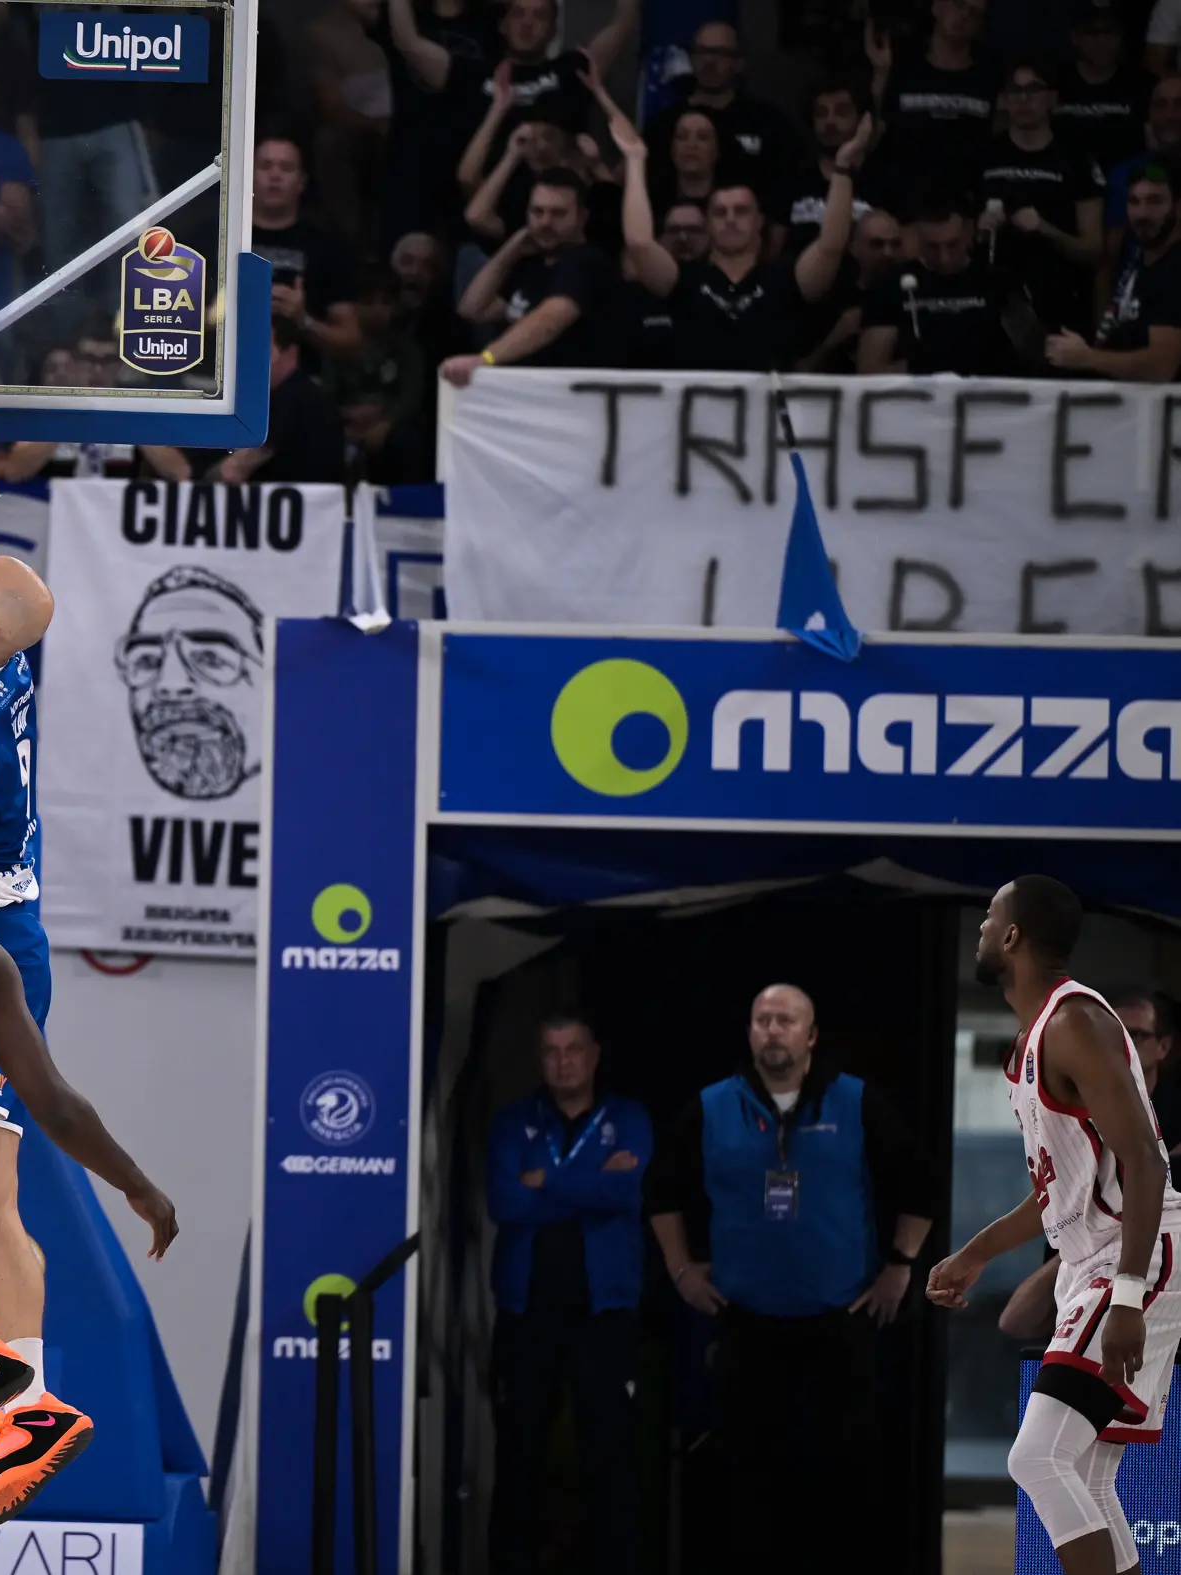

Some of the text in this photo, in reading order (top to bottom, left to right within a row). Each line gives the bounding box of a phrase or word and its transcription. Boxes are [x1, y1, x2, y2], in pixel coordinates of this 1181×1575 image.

[76, 22, 181, 71] Unipol
[134, 287, 195, 311] LBA
[144, 315, 183, 323] SERIE A
[138, 337, 188, 360] Unipol
[122, 482, 305, 553] CIANO
[711, 689, 1181, 781] mazza
[129, 815, 260, 889] VIVE
[282, 946, 400, 970] mazza
[314, 1156, 397, 1175] GERMANI
